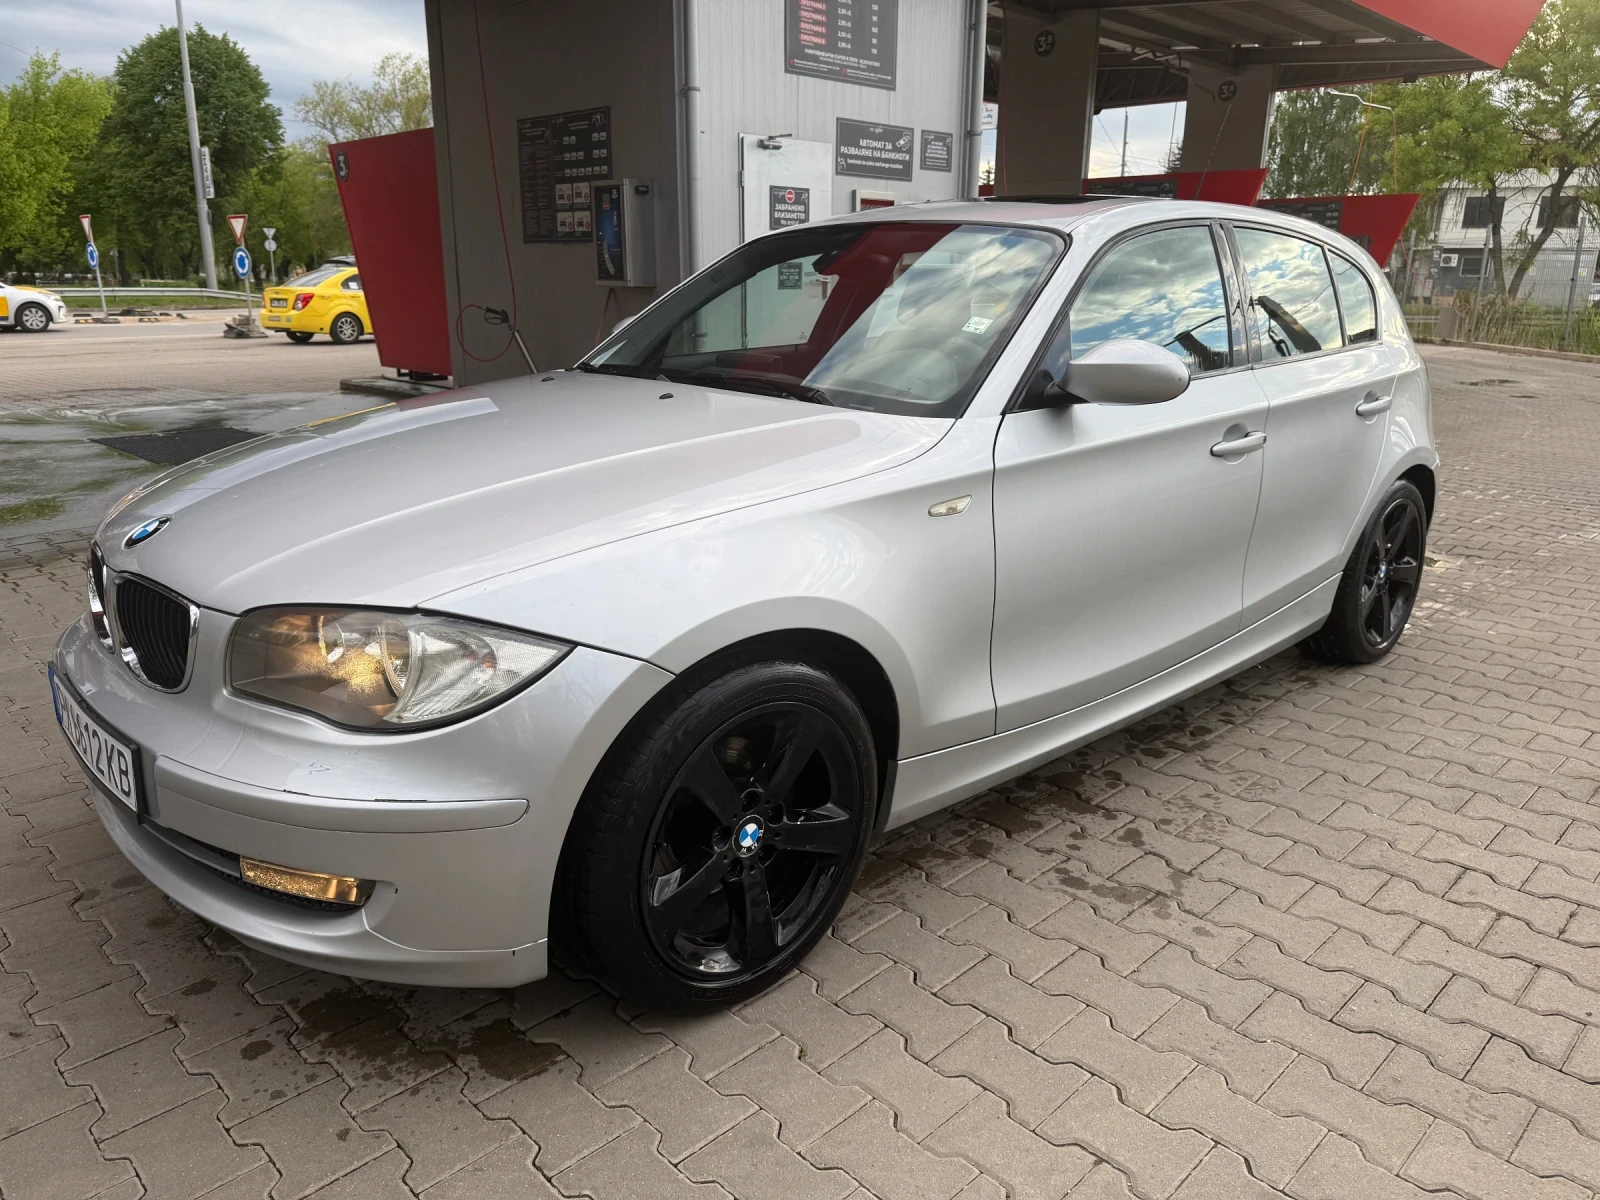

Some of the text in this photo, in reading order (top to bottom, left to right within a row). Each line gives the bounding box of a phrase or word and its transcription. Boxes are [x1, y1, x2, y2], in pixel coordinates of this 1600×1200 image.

[859, 138, 893, 150] АВТОМАТ ЗА
[840, 145, 910, 161] РАЗВАЛЯНЕ НА БАНКНОТИ
[774, 203, 805, 212] ЗАБРАНЕНО
[774, 211, 806, 220] ВЛИЗАНЕТО!
